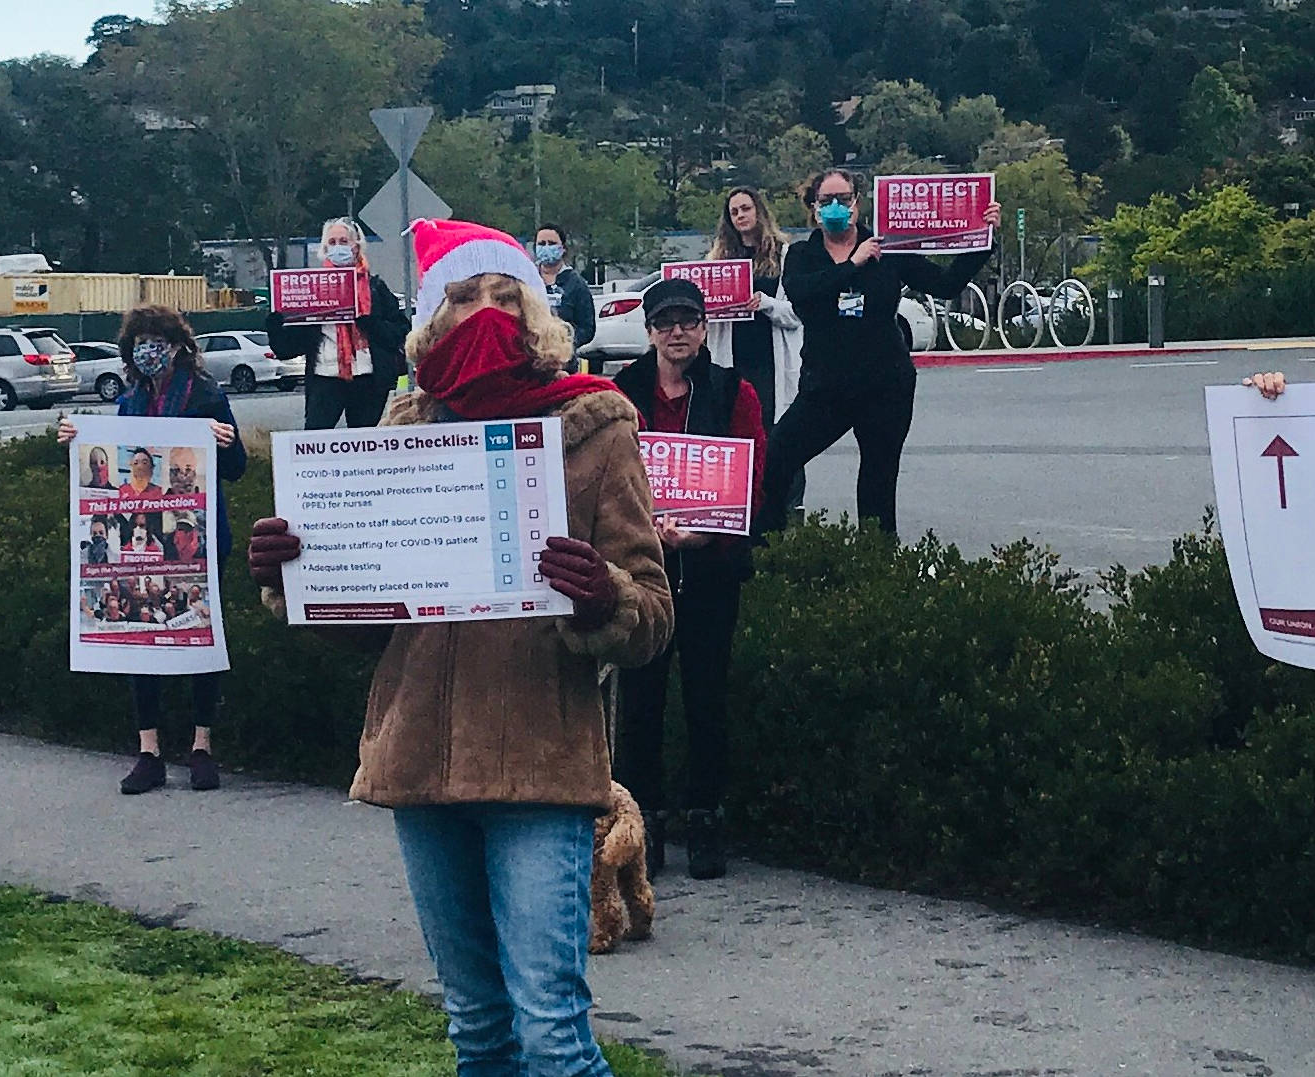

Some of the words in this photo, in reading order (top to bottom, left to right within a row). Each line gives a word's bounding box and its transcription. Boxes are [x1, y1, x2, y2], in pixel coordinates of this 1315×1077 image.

[888, 181, 980, 198] PROTECT
[888, 201, 929, 210] NURSES
[888, 211, 938, 220] PATIENTS
[888, 220, 925, 229] PUBLIC
[927, 219, 968, 228] HEALTH
[280, 272, 347, 286] PROTECT
[671, 264, 742, 280] PROTECT
[295, 442, 327, 456] NNU
[330, 438, 400, 455] COVID-19
[404, 433, 480, 450] Checklist:
[489, 434, 509, 445] YES
[521, 433, 537, 443] NO
[639, 440, 736, 465] ROTECT
[301, 467, 341, 479] COVID-19
[342, 467, 375, 479] patient
[377, 464, 417, 477] properly
[301, 490, 344, 501] Adequate
[345, 487, 385, 498] Personal
[386, 485, 434, 496] Protective
[435, 482, 484, 495] Equipment
[665, 488, 718, 501] HEALTH
[87, 500, 108, 512] This
[108, 500, 118, 511] Is
[118, 498, 141, 511] NOT
[142, 496, 199, 510] Protection.
[301, 500, 327, 510] (PPE)
[328, 500, 341, 509] for
[343, 500, 373, 508] nurses
[303, 519, 355, 532] Notification
[356, 520, 367, 529] to
[368, 518, 390, 528] staff
[391, 517, 418, 527] about
[419, 514, 463, 525] COVID-19
[464, 515, 486, 523] case
[306, 542, 347, 553] Adequate
[349, 540, 384, 552] staffing
[385, 539, 398, 548] for
[400, 537, 444, 547] COVID-19
[445, 536, 478, 547] patient
[308, 563, 349, 575] Adequate
[350, 561, 382, 573] testing
[310, 583, 339, 593] Nurses
[340, 581, 377, 594] properly
[379, 580, 410, 592] placed
[411, 581, 424, 590] on
[425, 579, 450, 589] leave
